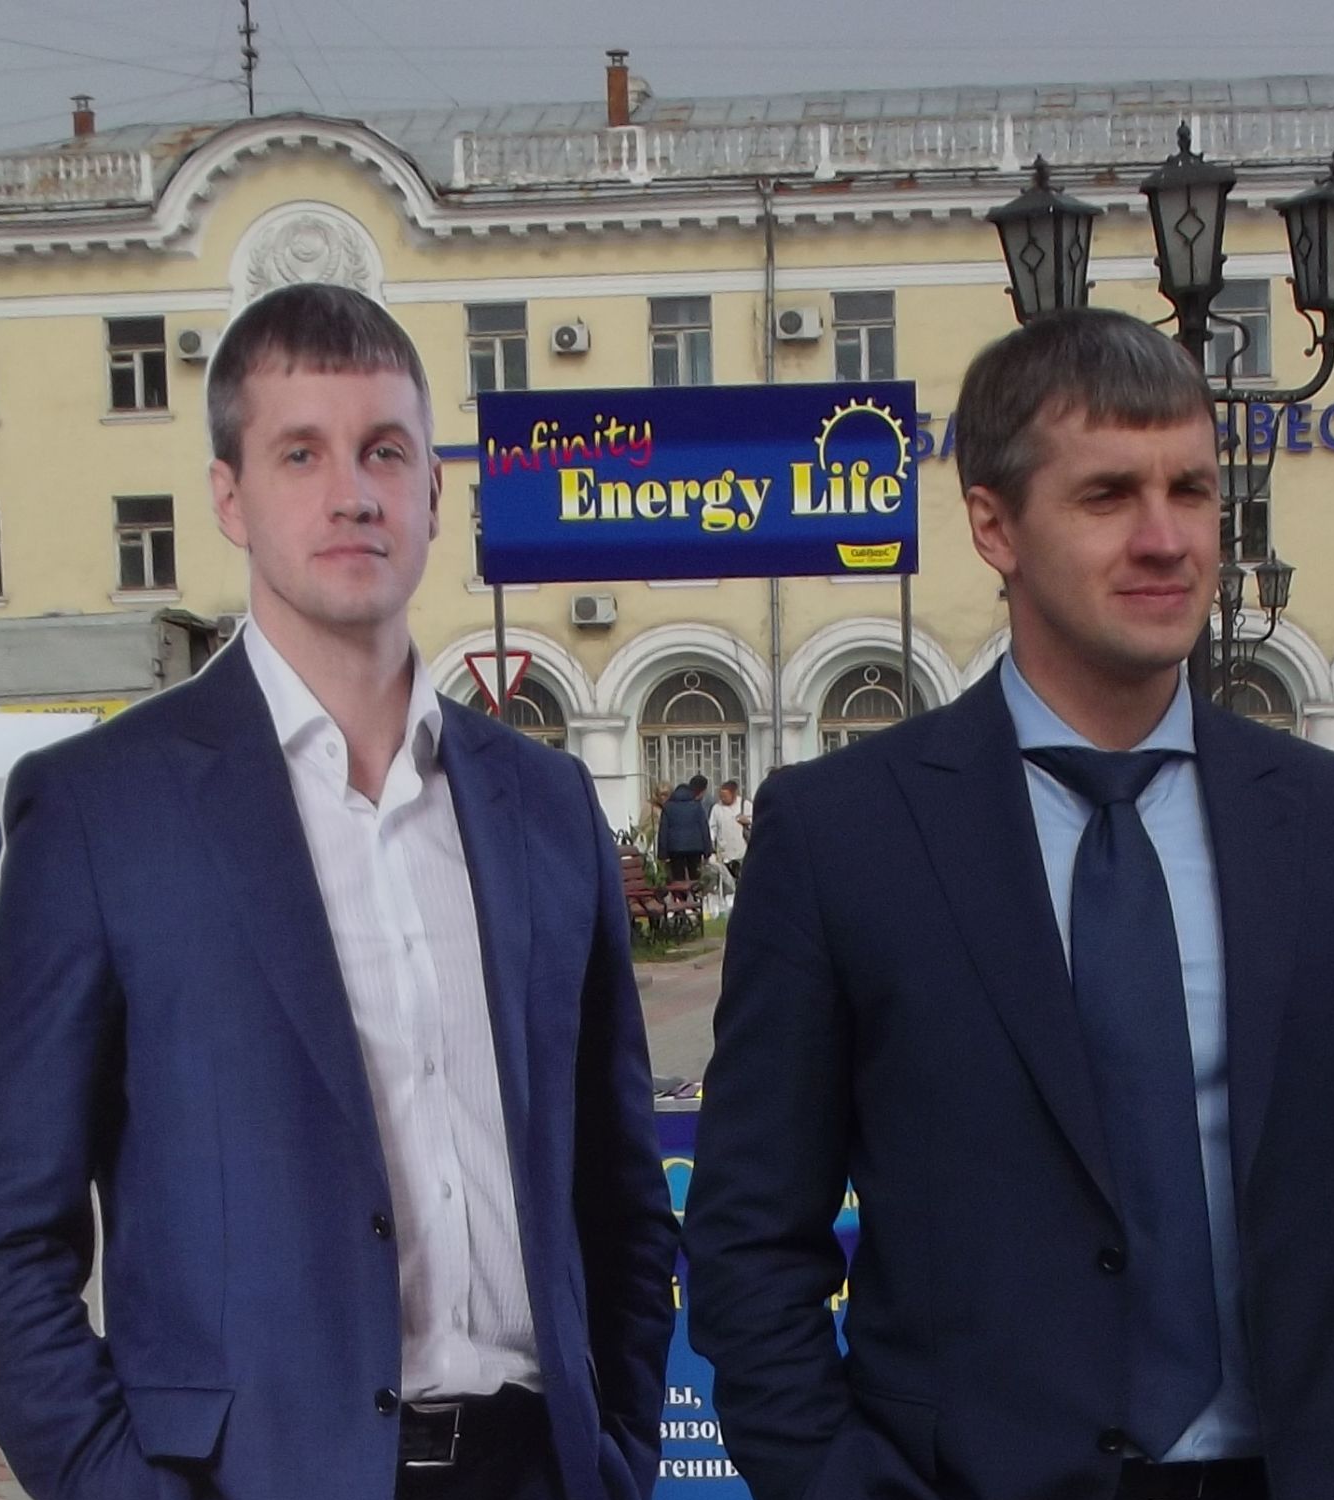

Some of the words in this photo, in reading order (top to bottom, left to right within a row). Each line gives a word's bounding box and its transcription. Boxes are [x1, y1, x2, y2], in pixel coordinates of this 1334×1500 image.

[485, 413, 653, 476] Infinity
[557, 467, 772, 533] Energy
[789, 459, 903, 516] Life
